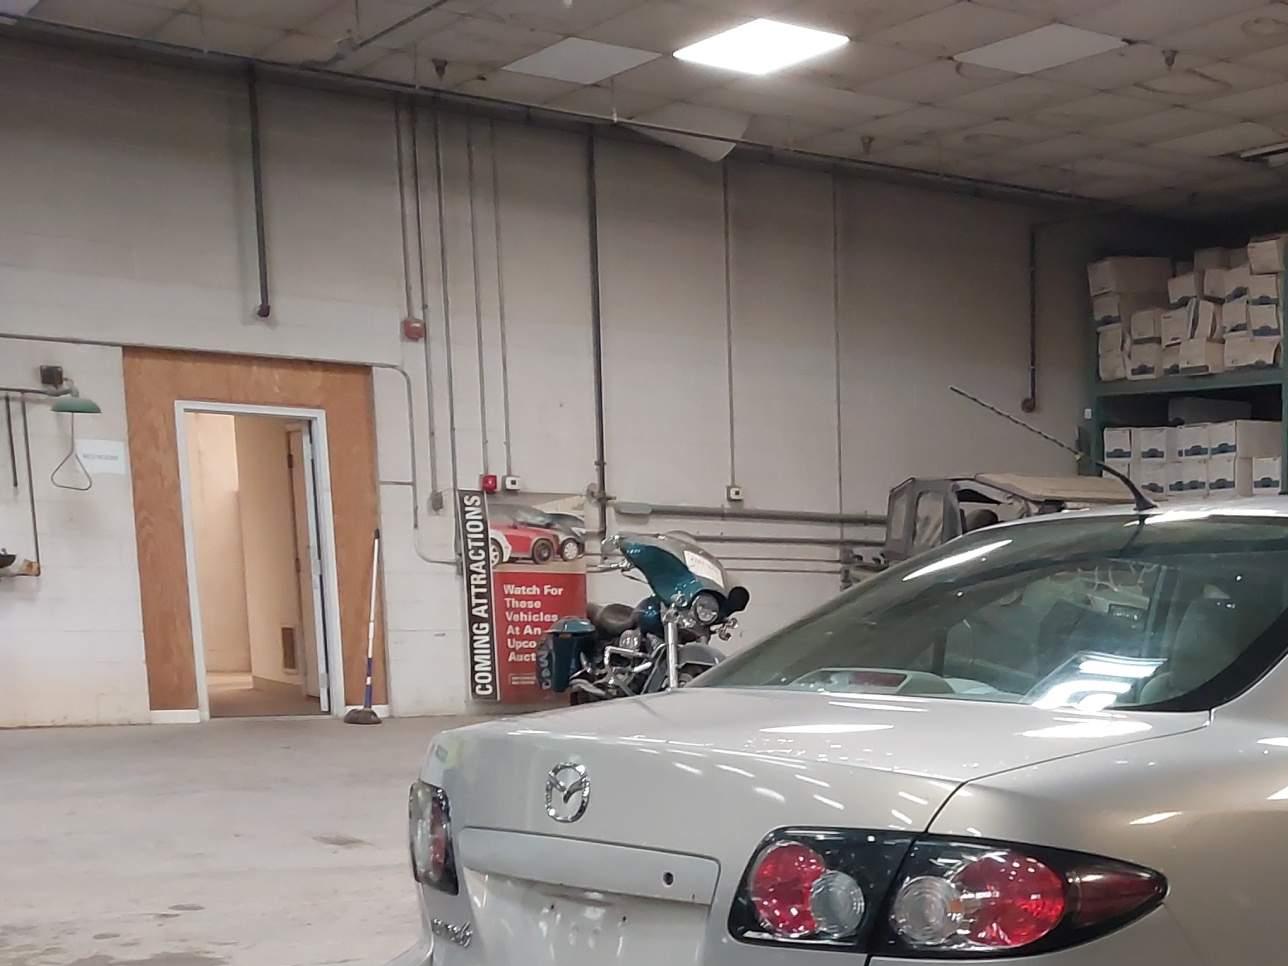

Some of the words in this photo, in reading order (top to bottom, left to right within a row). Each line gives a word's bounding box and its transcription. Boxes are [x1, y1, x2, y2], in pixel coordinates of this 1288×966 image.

[463, 494, 489, 618] ATTRACTIONS
[503, 584, 540, 595] Watch
[543, 584, 564, 596] For
[505, 611, 559, 622] Vehicles
[506, 624, 520, 635] At
[523, 624, 541, 635] An
[507, 638, 537, 650] Upco
[472, 622, 493, 696] COMING
[508, 651, 537, 662] Auct
